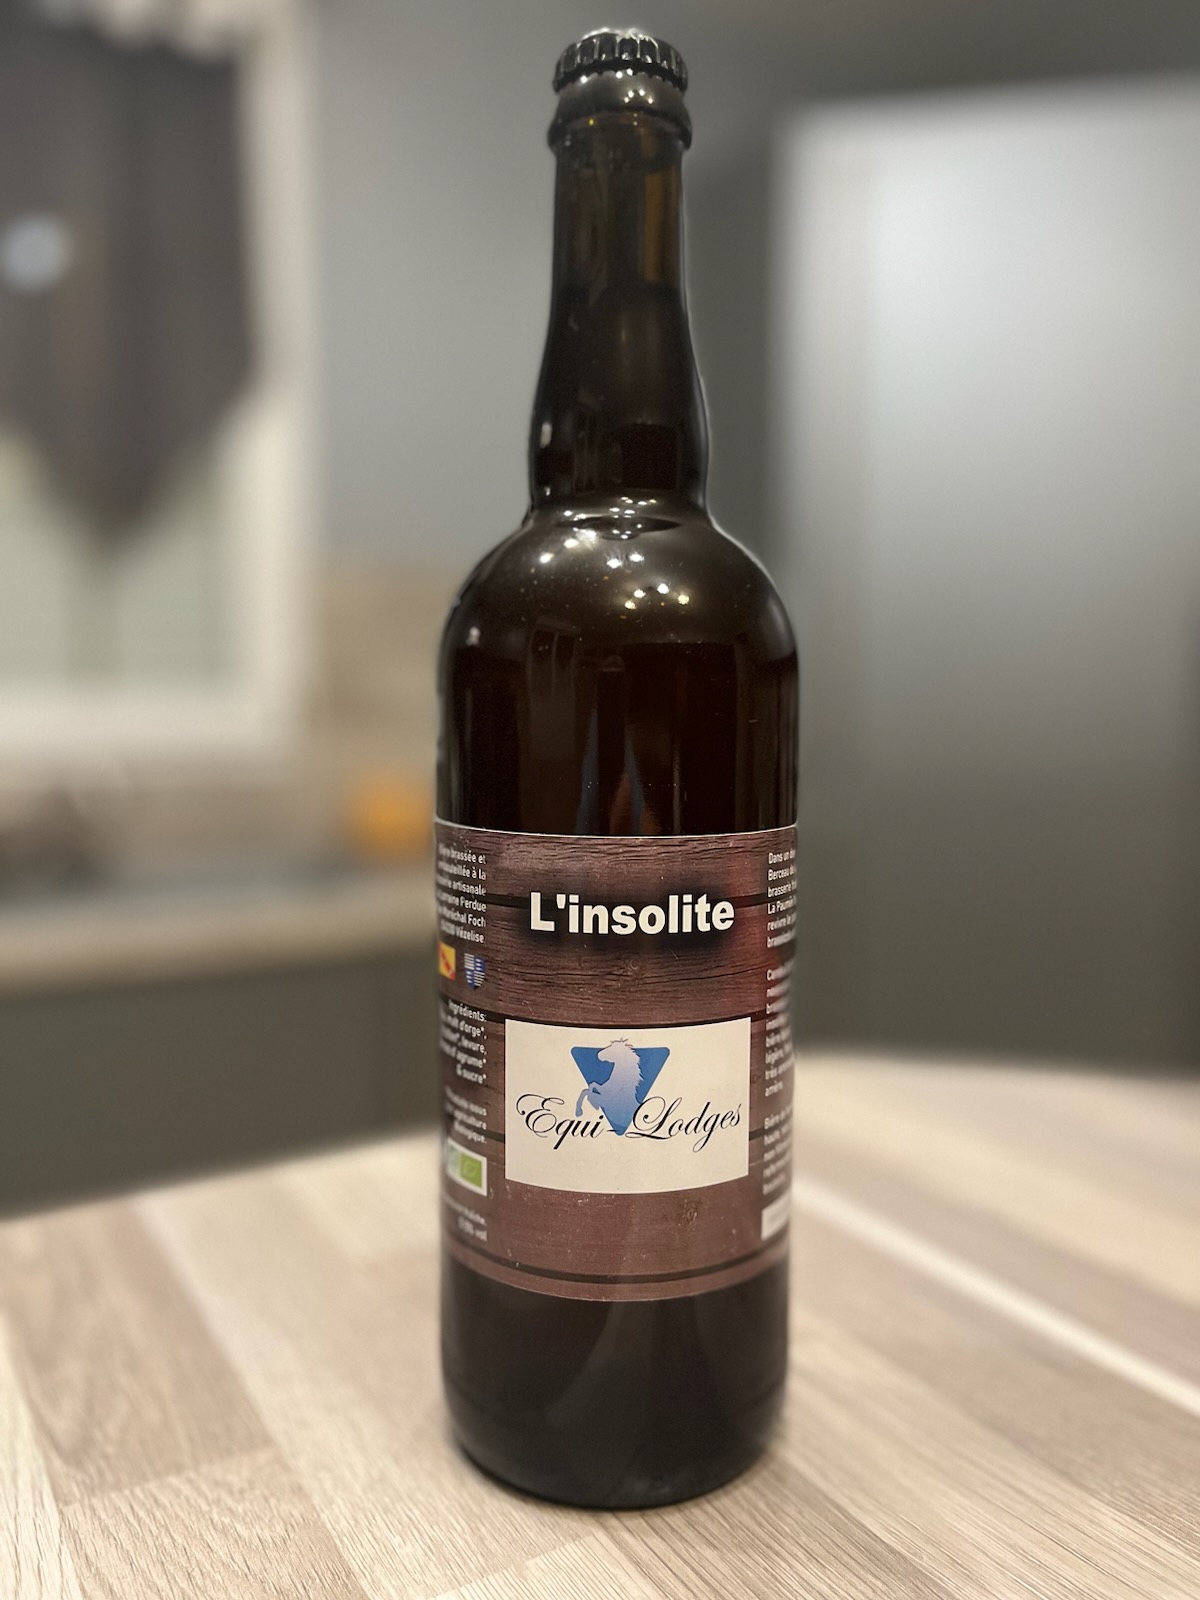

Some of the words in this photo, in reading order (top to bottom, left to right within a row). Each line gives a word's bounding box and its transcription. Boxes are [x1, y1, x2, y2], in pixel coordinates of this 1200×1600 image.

[450, 847, 476, 862] brassée
[478, 854, 487, 865] et
[768, 852, 783, 864] Dans
[472, 867, 477, 879] à
[478, 868, 486, 880] la
[767, 866, 789, 881] Berceau
[452, 880, 486, 896] artisanale
[767, 881, 791, 898] brasserie
[460, 896, 487, 913] Perdue
[767, 903, 776, 914] La
[467, 913, 487, 928] Foch
[530, 891, 735, 935] L'insolite
